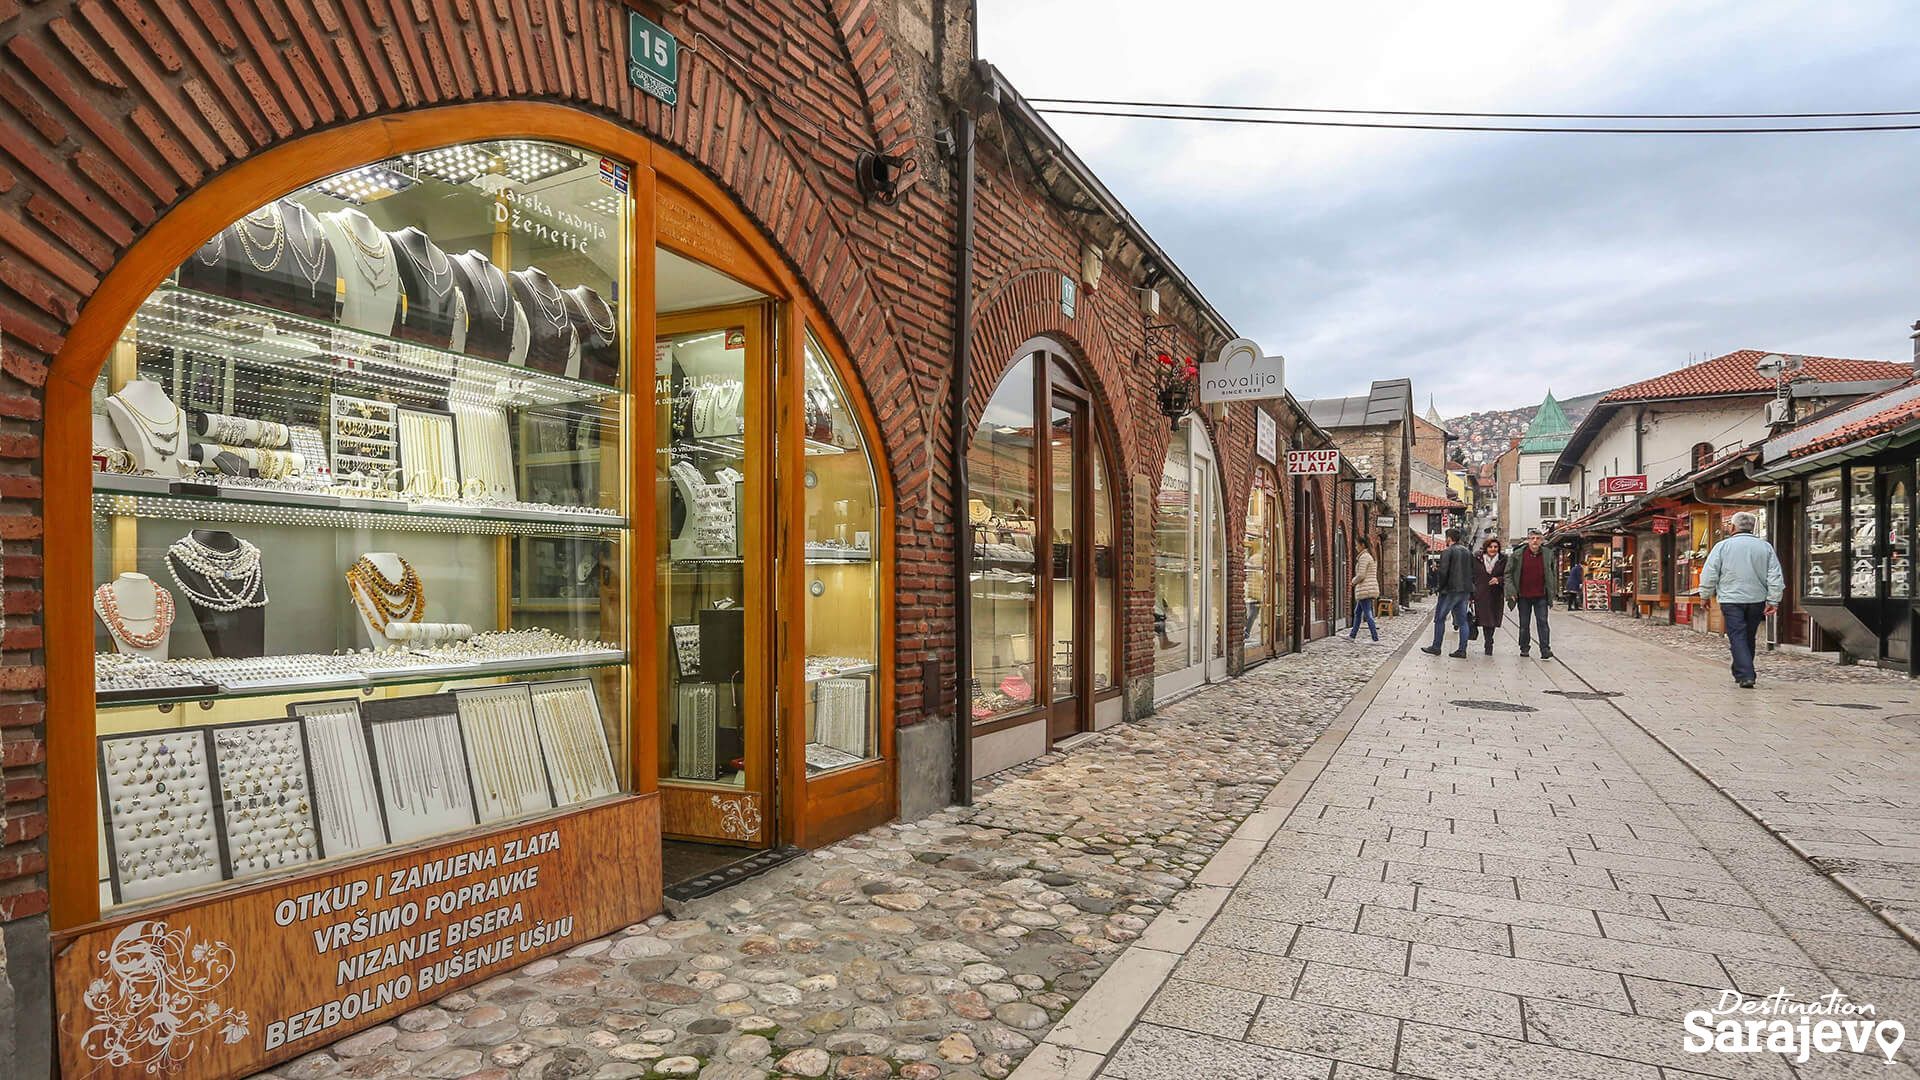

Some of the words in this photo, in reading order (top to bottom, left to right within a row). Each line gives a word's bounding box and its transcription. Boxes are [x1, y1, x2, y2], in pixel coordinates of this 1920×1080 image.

[639, 29, 668, 67] 15
[494, 201, 589, 253] Dženetić
[557, 209, 608, 240] radnja
[1206, 372, 1276, 390] novalija
[1289, 451, 1338, 462] OTKUP
[1289, 462, 1337, 473] ZLATA
[274, 879, 369, 927] OTKUP
[374, 875, 384, 900] I
[389, 847, 498, 896] ZAMJENA
[502, 831, 560, 868] ZLATA
[313, 901, 417, 954] VRŠIMO
[424, 866, 539, 919] POPRAVKE
[336, 939, 440, 986] NIZANJE
[446, 902, 524, 945] BISERA
[265, 977, 413, 1051] BEZBOLNO
[417, 938, 514, 993] BUŠENJE
[518, 914, 573, 954] UŠIJU
